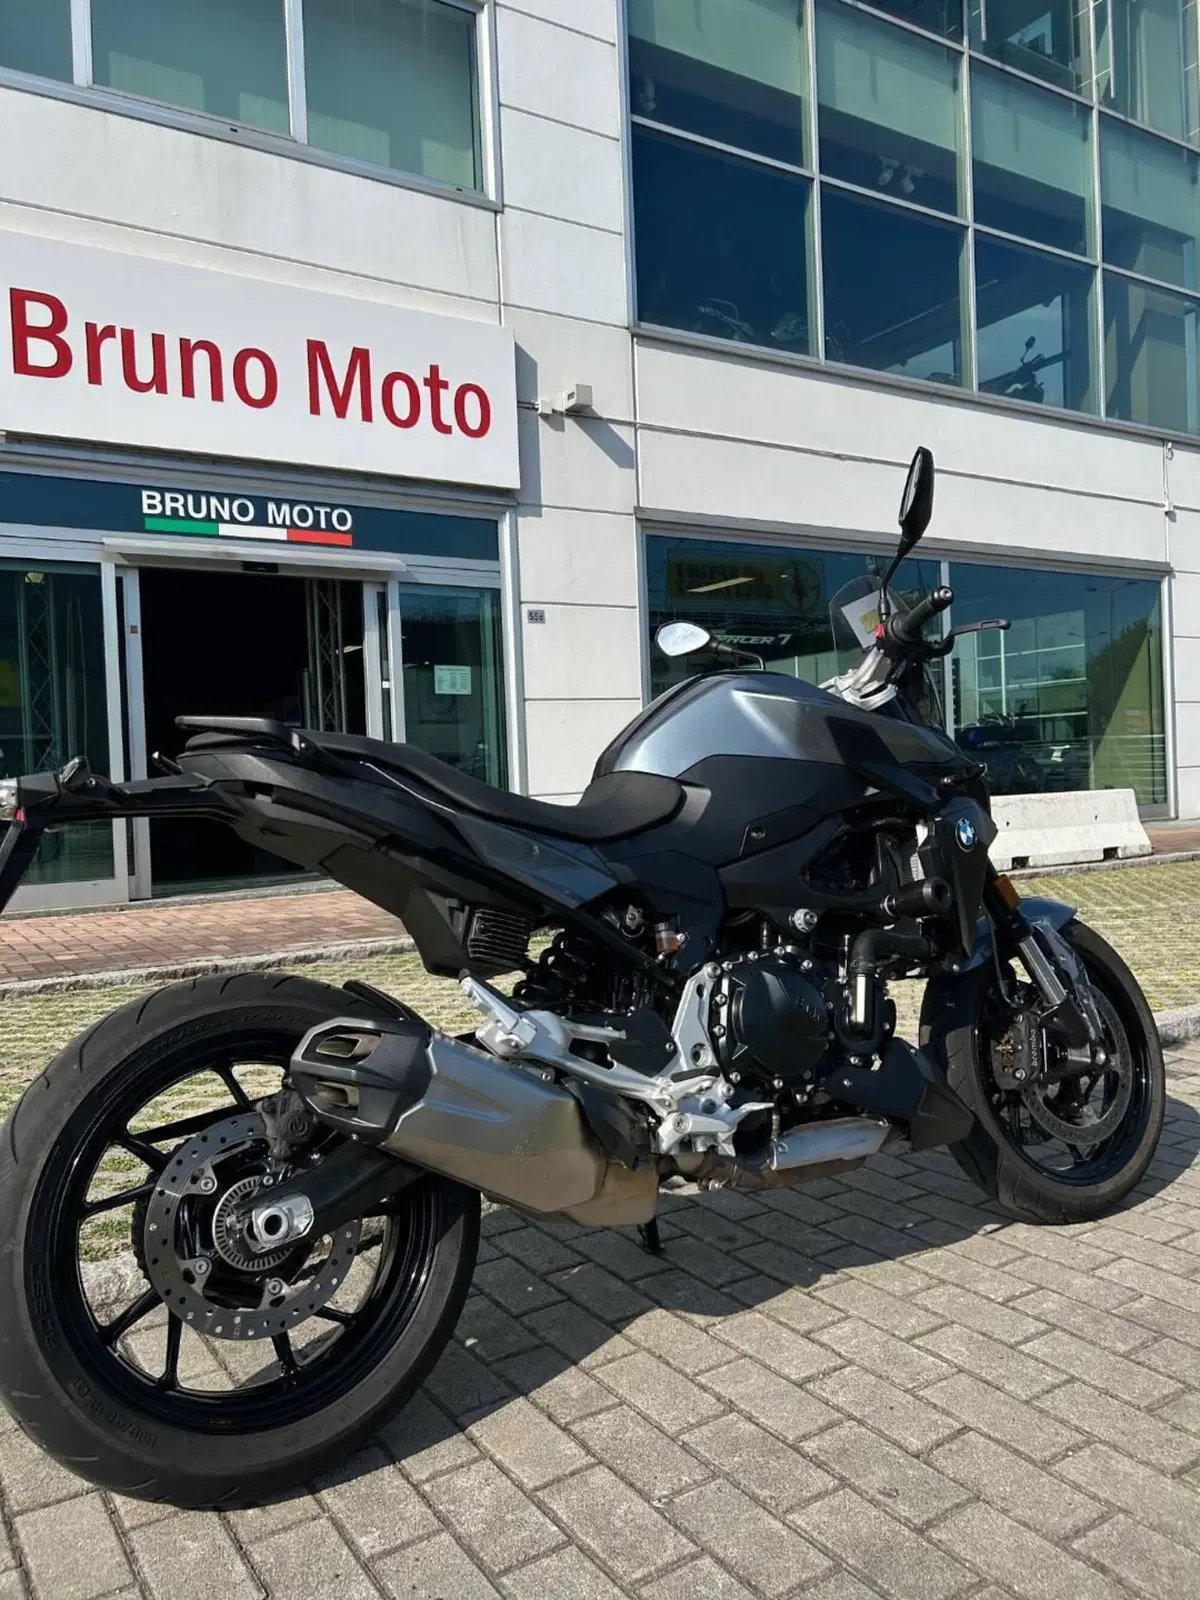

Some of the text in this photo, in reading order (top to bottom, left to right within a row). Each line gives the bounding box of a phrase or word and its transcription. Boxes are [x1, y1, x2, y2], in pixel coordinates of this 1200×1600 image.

[9, 287, 492, 439] Bruno Moto
[141, 490, 352, 531] BRUNO MOTO
